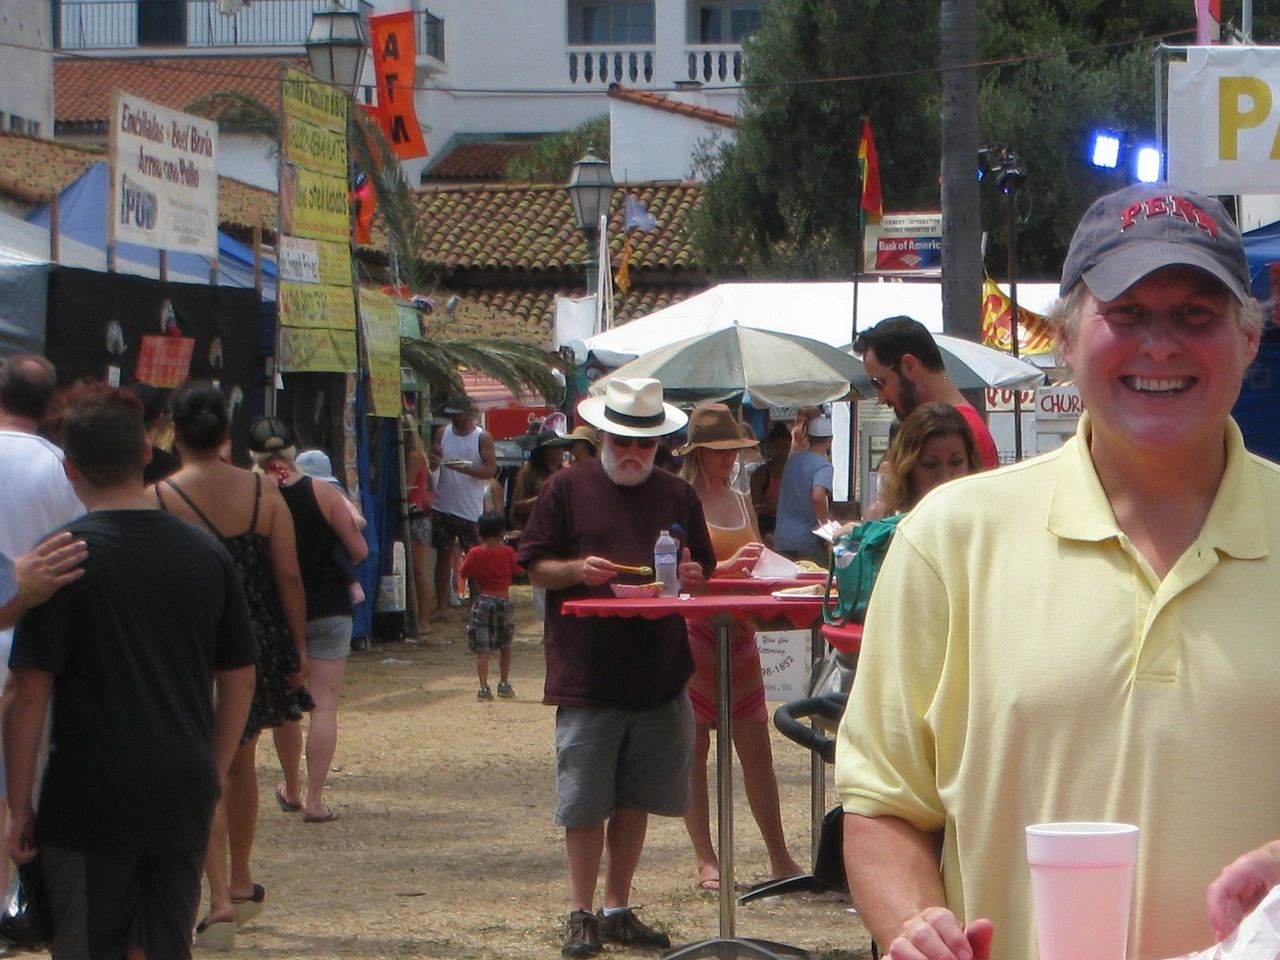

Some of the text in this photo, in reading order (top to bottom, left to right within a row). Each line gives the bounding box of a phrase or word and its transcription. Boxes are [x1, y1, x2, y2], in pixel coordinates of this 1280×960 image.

[1120, 195, 1219, 241] PENN
[880, 240, 941, 251] Bank of Americ
